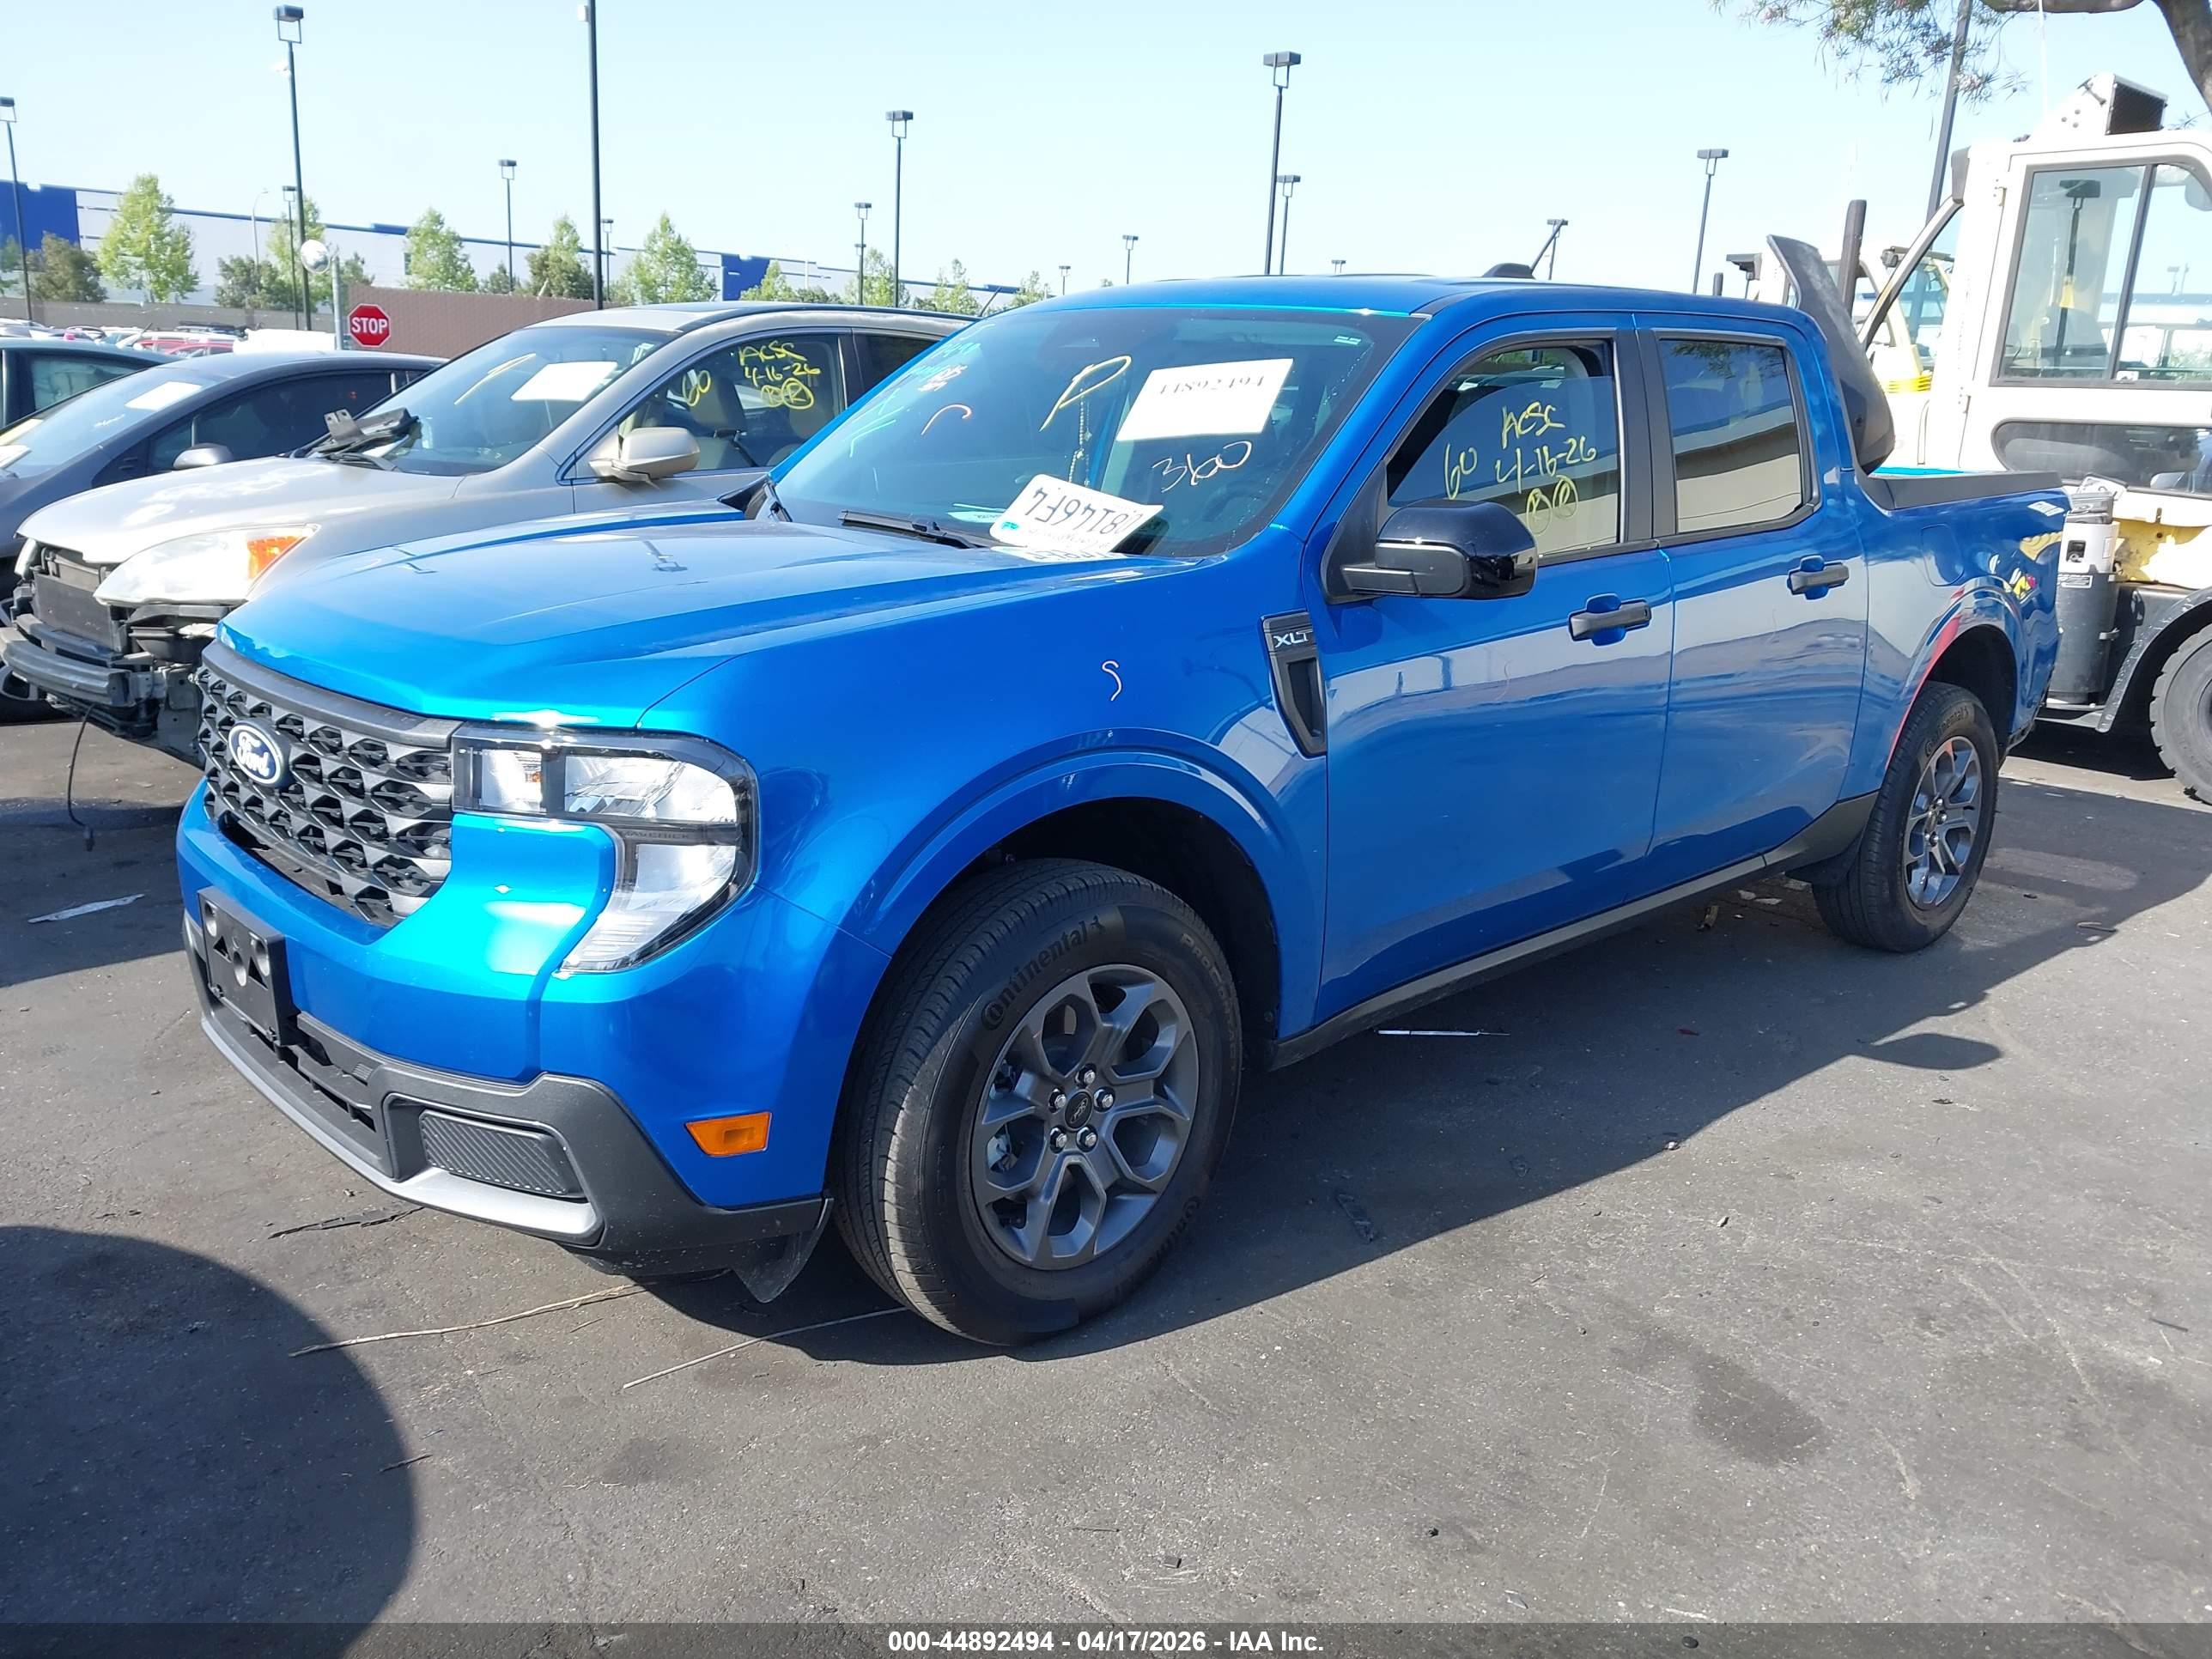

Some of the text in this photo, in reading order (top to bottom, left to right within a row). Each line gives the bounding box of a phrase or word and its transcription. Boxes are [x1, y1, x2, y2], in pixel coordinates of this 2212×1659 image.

[351, 316, 388, 335] STOP
[1273, 629, 1314, 648] XLT
[236, 731, 270, 777] Ford
